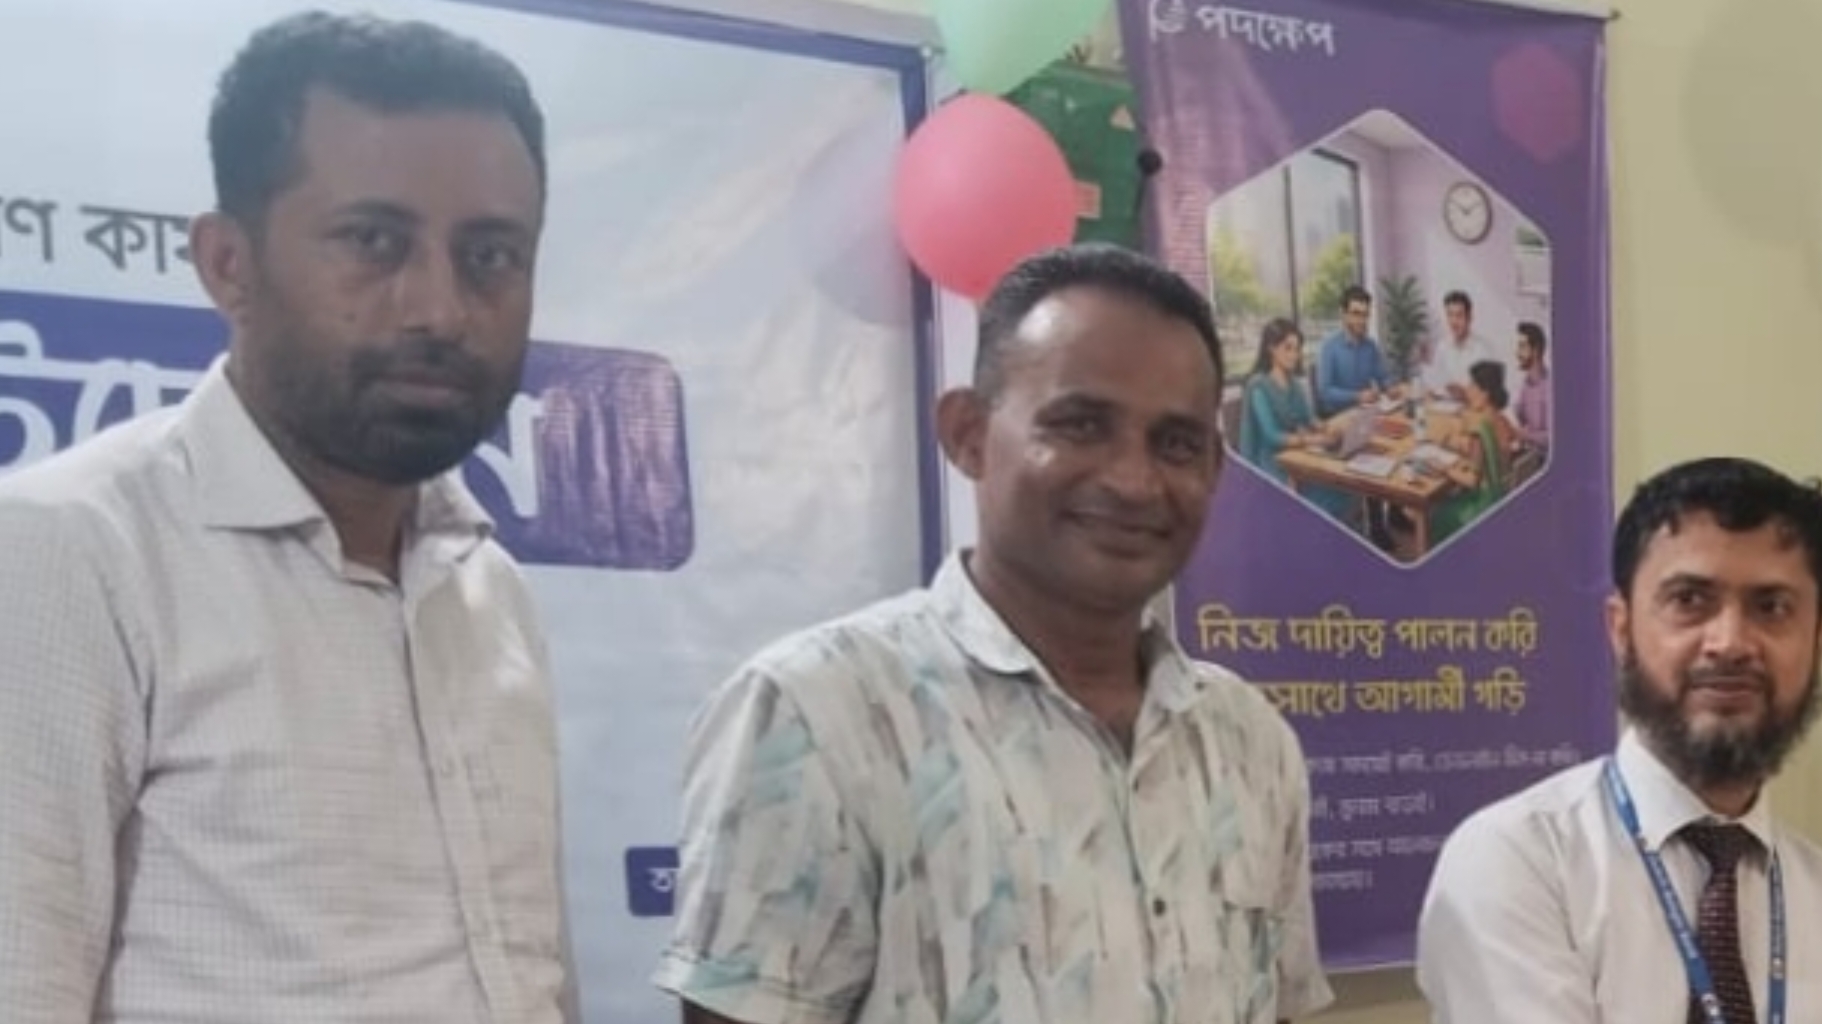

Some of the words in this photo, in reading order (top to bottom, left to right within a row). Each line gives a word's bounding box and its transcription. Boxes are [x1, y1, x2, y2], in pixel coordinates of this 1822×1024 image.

[1196, 6, 1336, 57] পদক্ষেপ
[1198, 603, 1280, 653] নিজ
[1285, 603, 1387, 660] দায়িত্ব
[1394, 617, 1478, 653] পালন
[1483, 607, 1538, 658] করি
[1250, 679, 1346, 719] সাথে
[1352, 665, 1466, 713] আগামী
[1472, 666, 1527, 716] গড়ি
